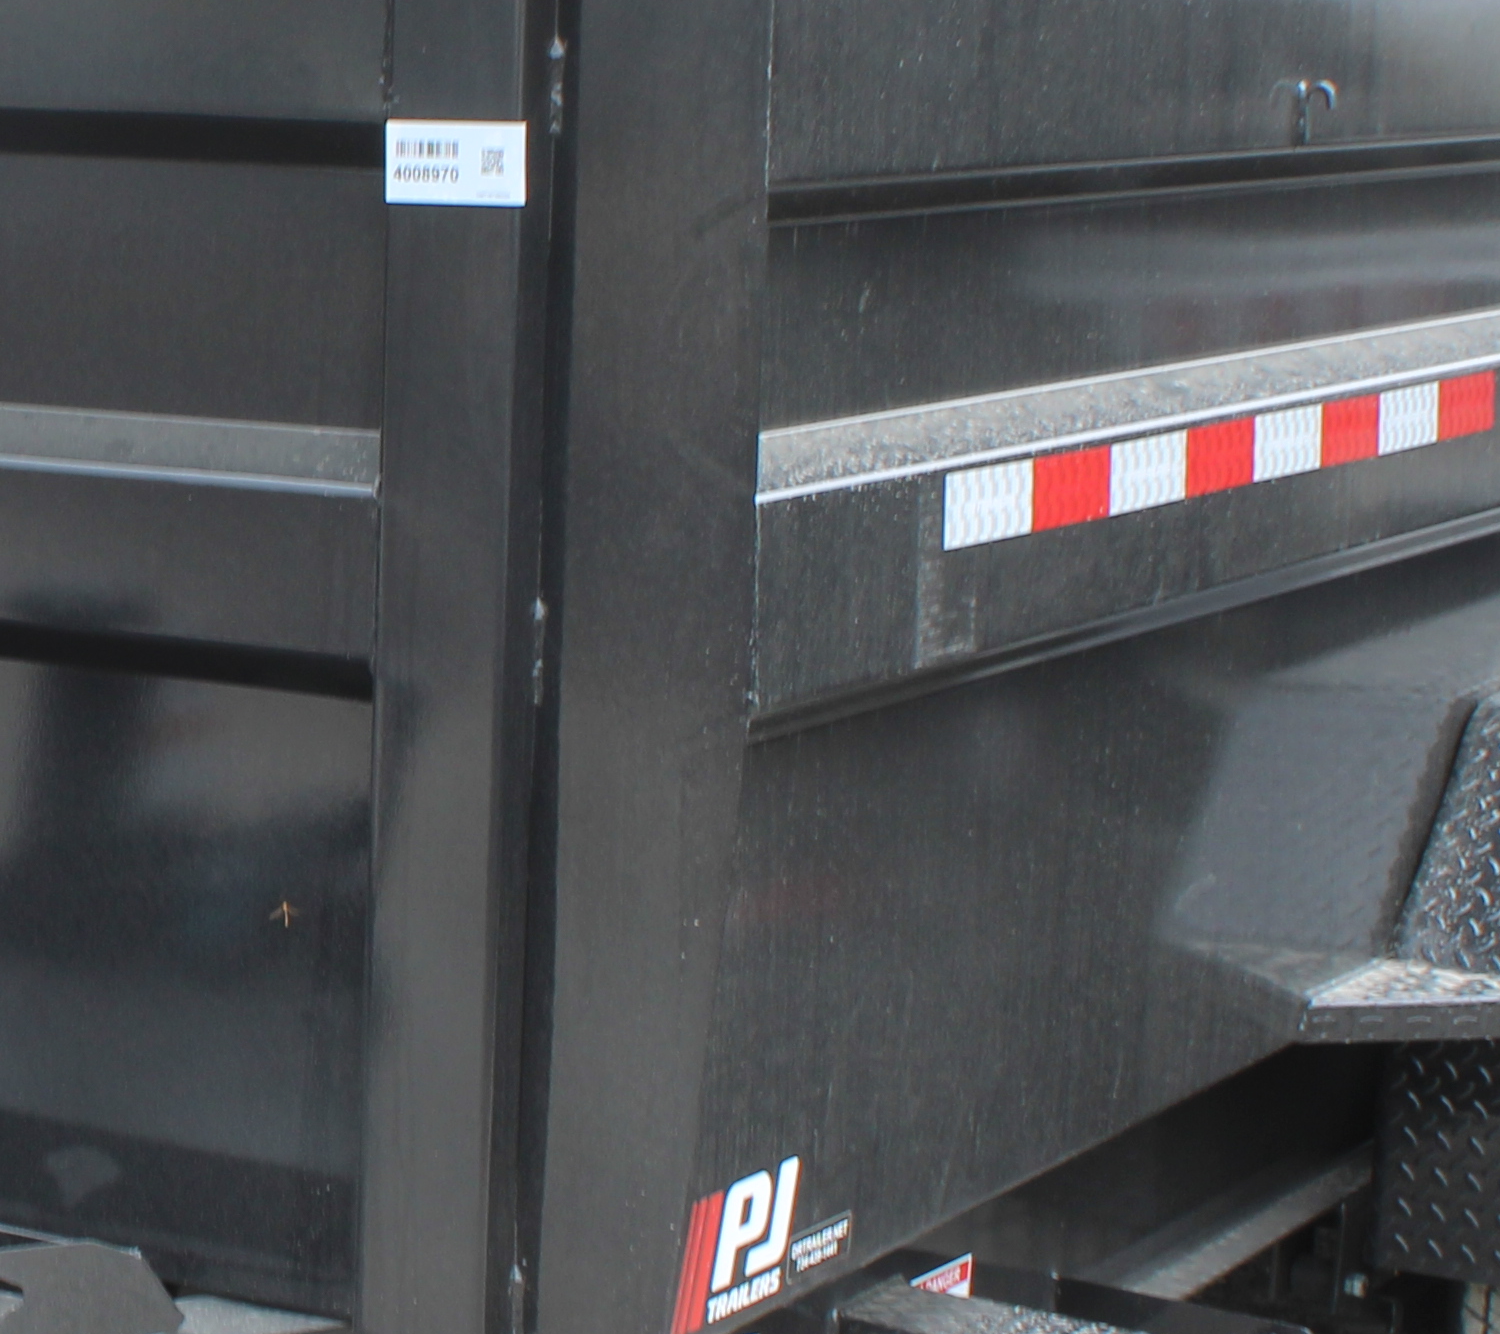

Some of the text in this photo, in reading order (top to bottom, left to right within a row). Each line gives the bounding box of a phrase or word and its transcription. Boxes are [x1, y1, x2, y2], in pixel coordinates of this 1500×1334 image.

[393, 164, 459, 184] 4008970
[709, 1155, 800, 1294] PJ
[706, 1267, 782, 1325] TRAILERS
